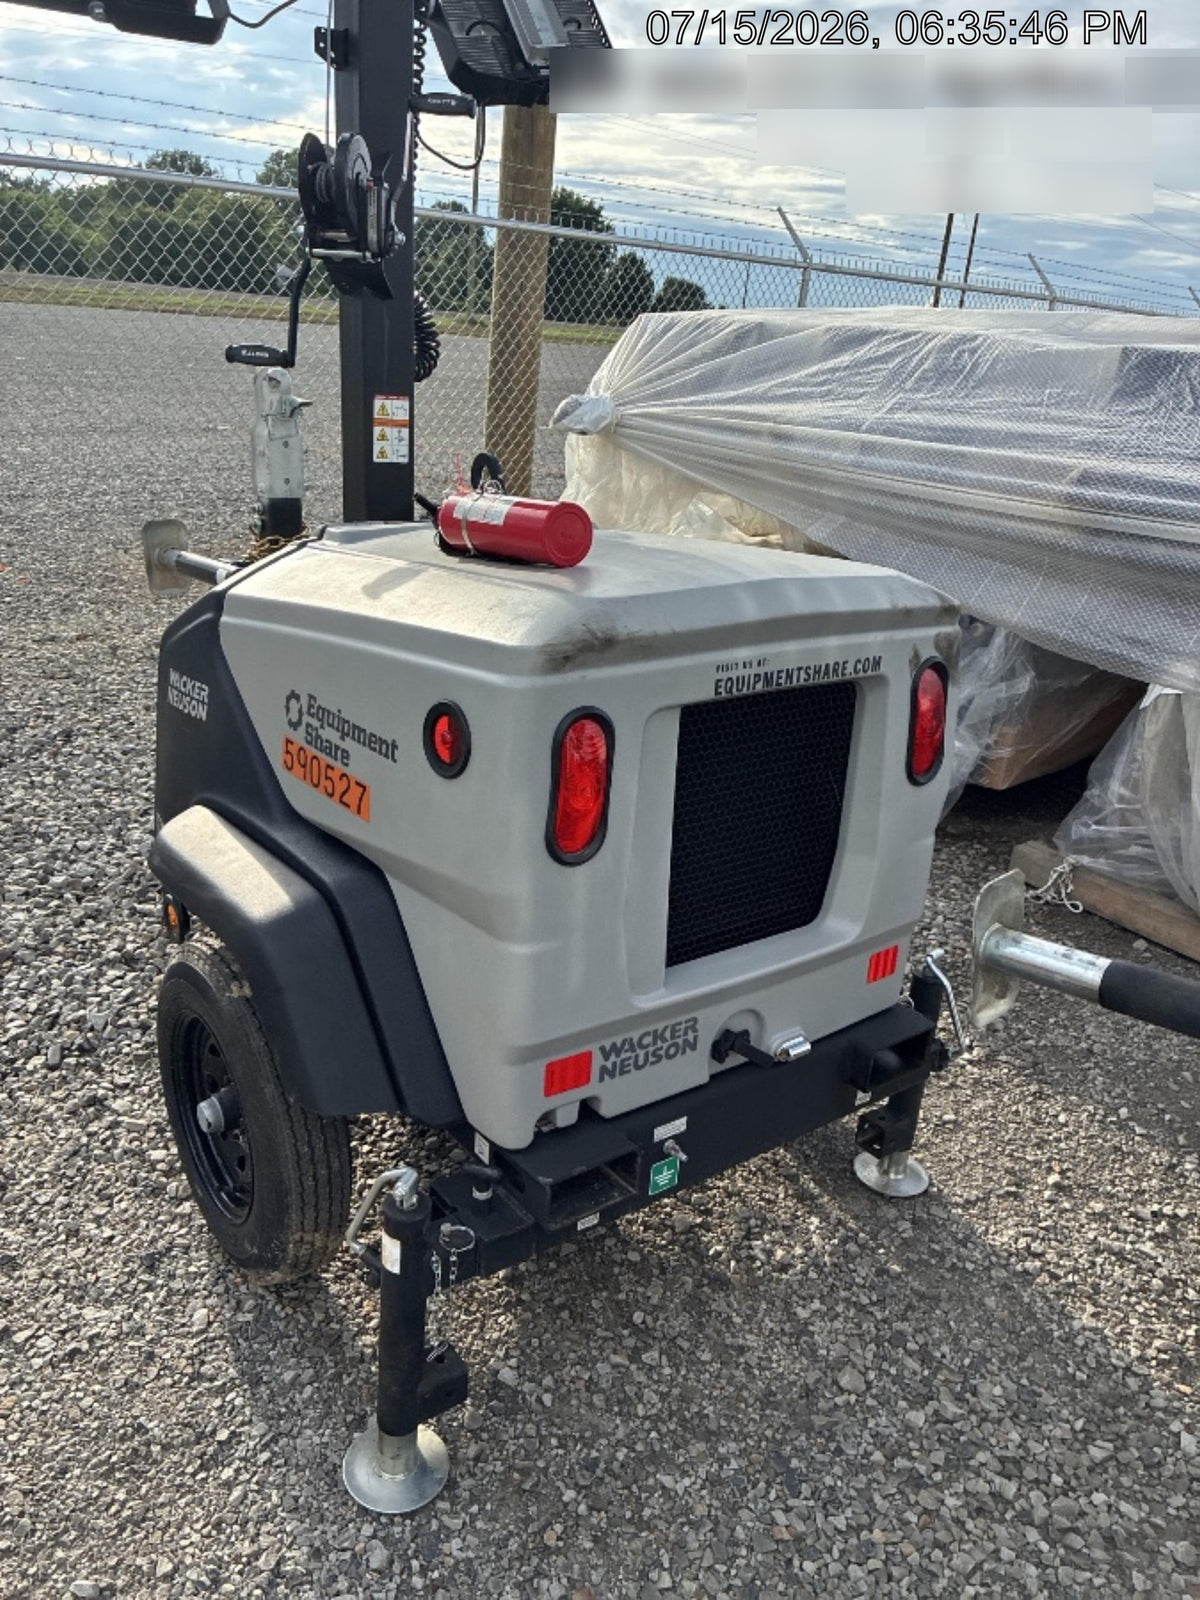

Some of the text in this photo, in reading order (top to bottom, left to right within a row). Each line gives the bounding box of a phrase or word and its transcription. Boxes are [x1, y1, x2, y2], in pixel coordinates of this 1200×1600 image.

[169, 668, 209, 703] WACKER
[714, 655, 883, 697] EQUIPMENTSHARE.COM
[168, 685, 208, 722] NEUSON
[304, 720, 351, 768] Share
[306, 693, 400, 763] Equipment
[283, 736, 368, 816] 590527
[599, 1016, 699, 1063] WACKER
[599, 1034, 699, 1083] NEUSON
